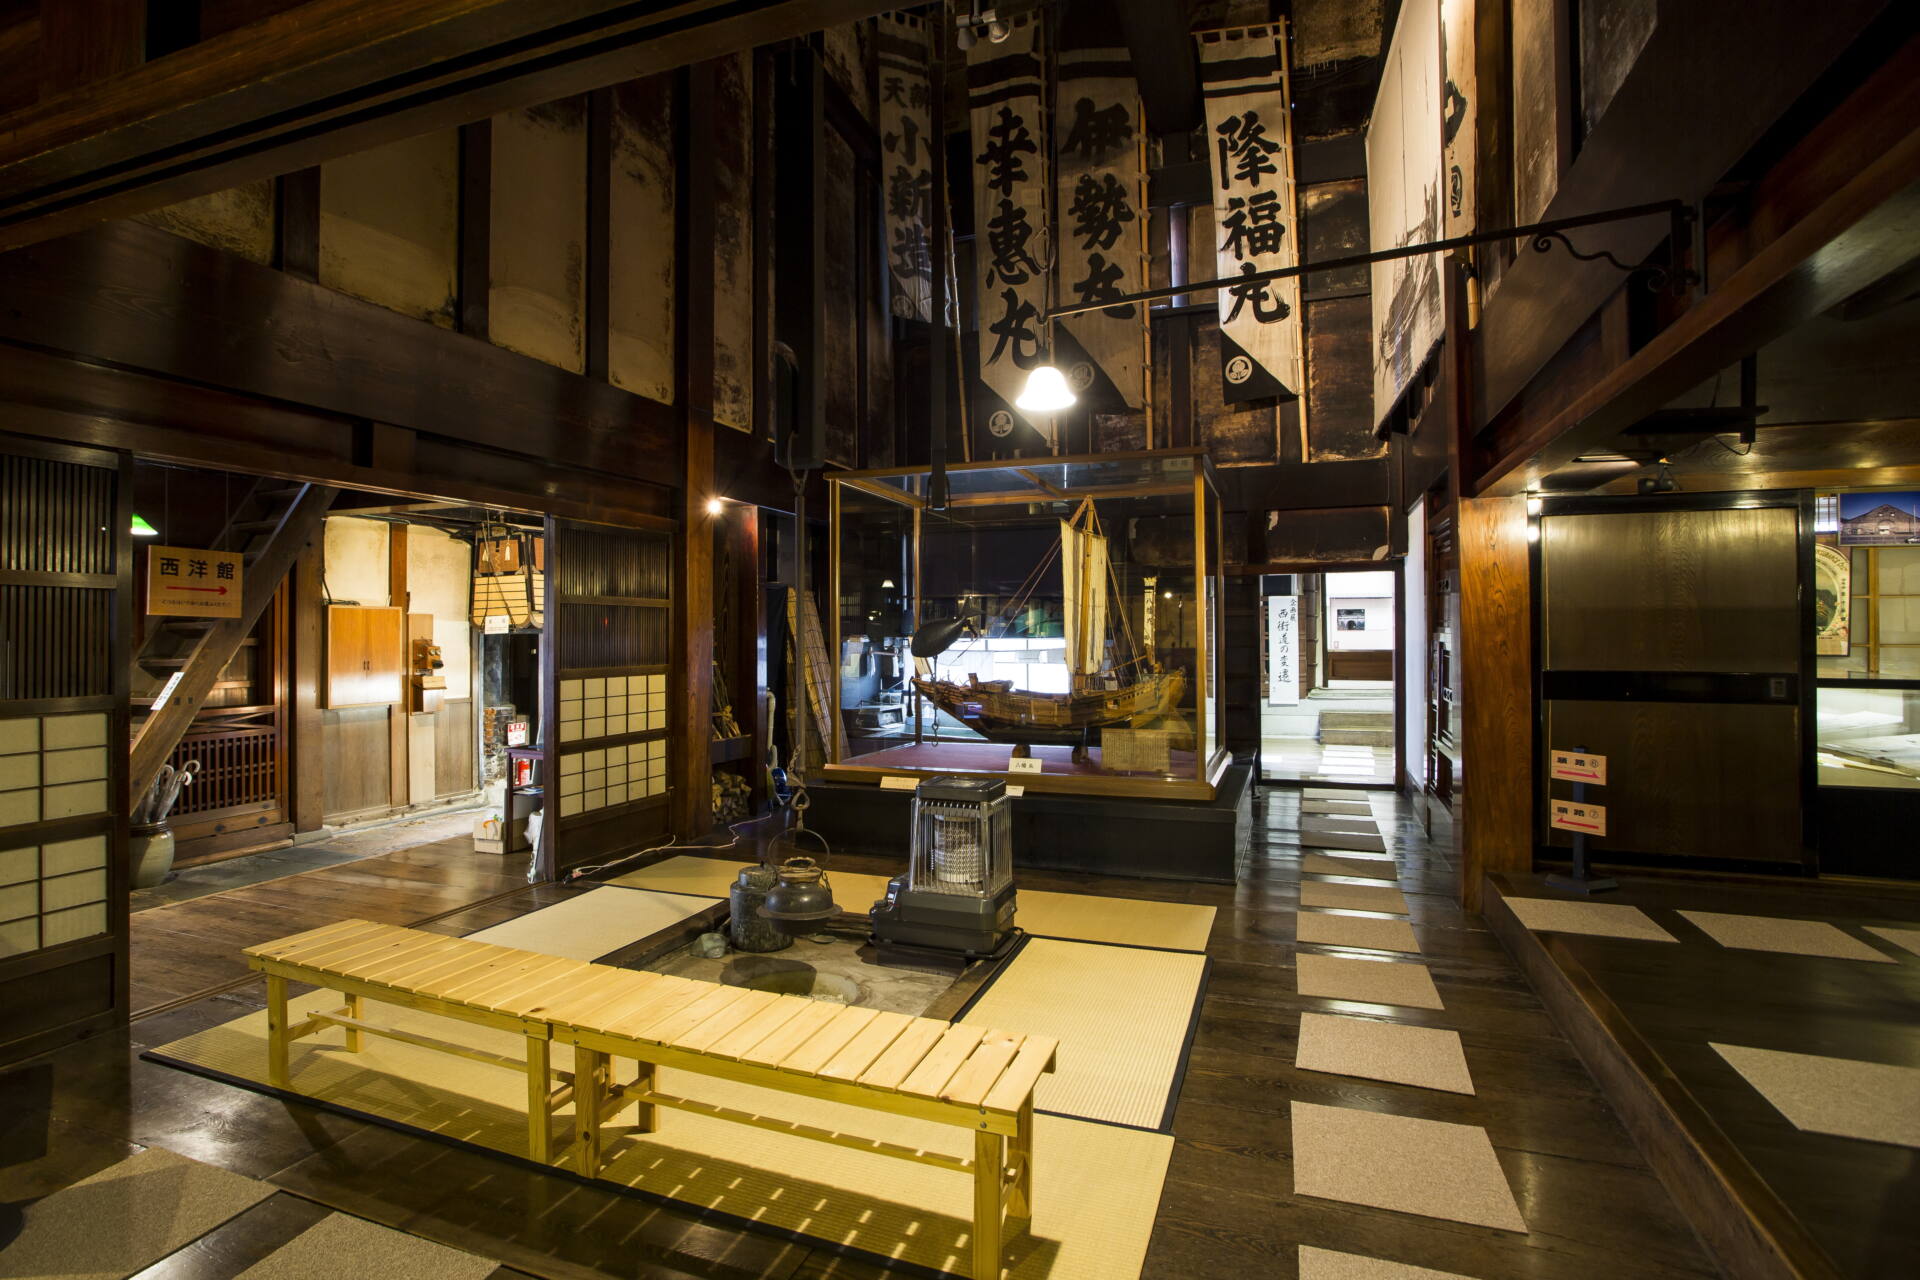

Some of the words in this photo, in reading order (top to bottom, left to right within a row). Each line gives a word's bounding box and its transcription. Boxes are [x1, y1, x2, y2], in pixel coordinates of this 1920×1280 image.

[1216, 110, 1291, 324] 隆福丸
[160, 557, 235, 580] 西洋館
